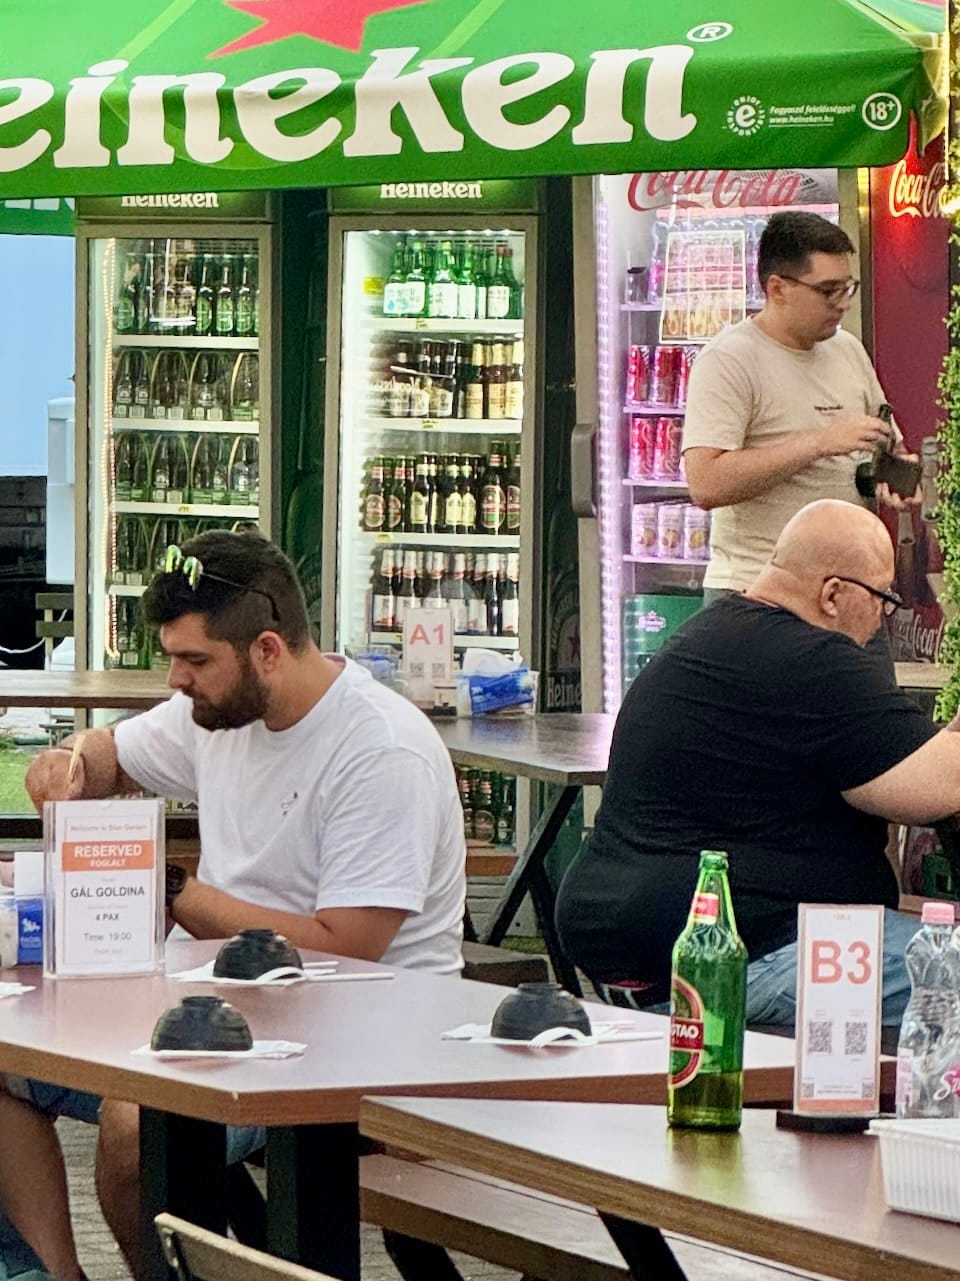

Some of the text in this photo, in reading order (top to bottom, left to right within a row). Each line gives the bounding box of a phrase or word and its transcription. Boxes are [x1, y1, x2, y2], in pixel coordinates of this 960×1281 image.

[869, 101, 896, 121] 18+
[380, 181, 483, 199] Heineken
[409, 623, 445, 646] A1
[74, 844, 142, 858] RESERVED
[70, 885, 145, 898] GÁL GOLDINA
[102, 913, 120, 921] PAX
[810, 939, 872, 985] B3
